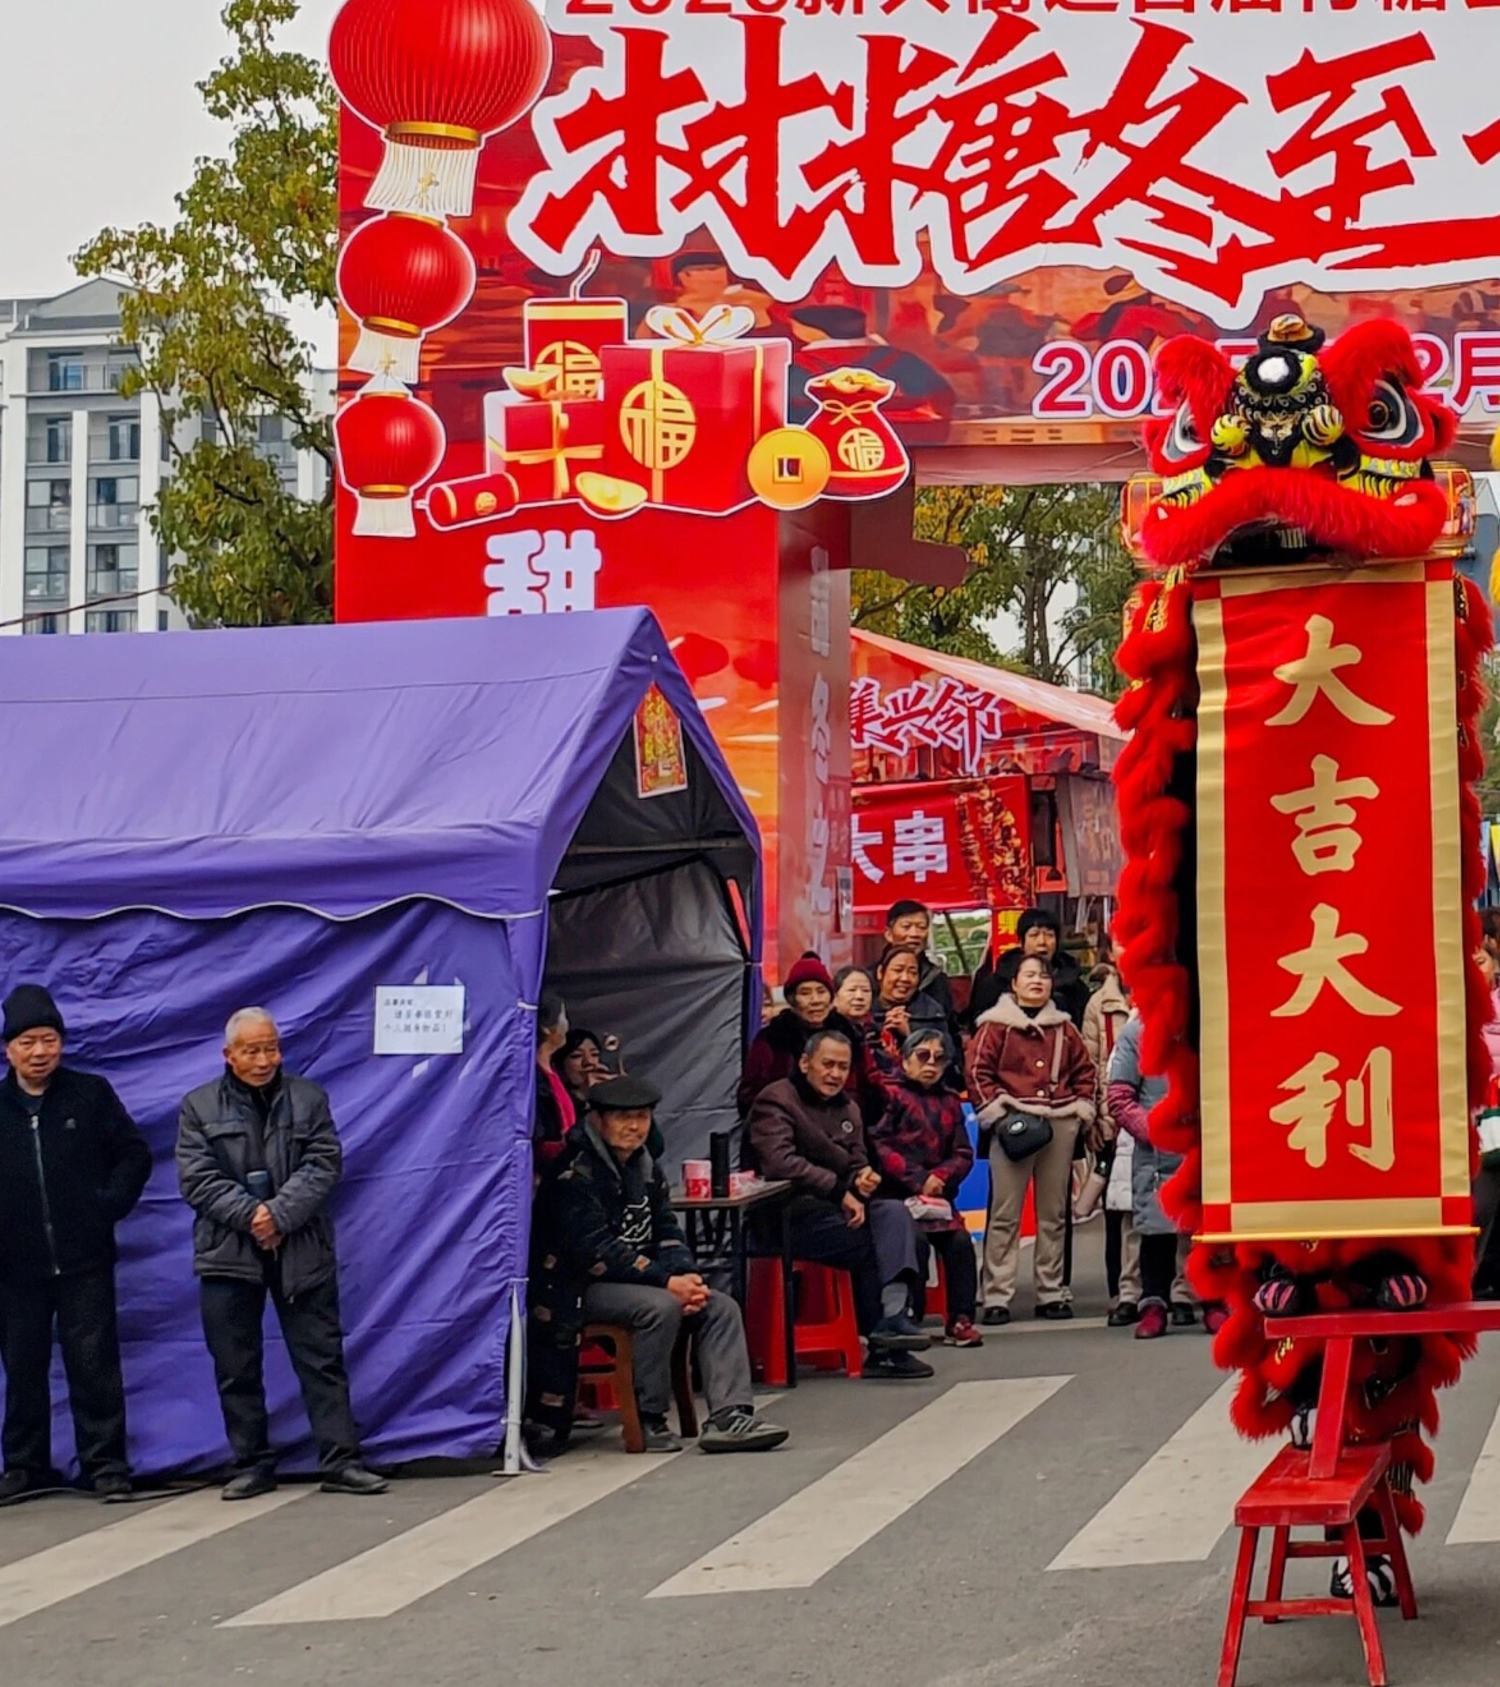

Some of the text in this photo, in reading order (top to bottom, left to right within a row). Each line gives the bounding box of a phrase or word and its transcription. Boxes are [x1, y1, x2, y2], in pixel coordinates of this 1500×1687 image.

[535, 340, 602, 398] 福
[620, 381, 697, 469] 福
[838, 428, 885, 471] 福
[484, 529, 602, 616] 甜
[1263, 613, 1404, 1172] 大吉大利
